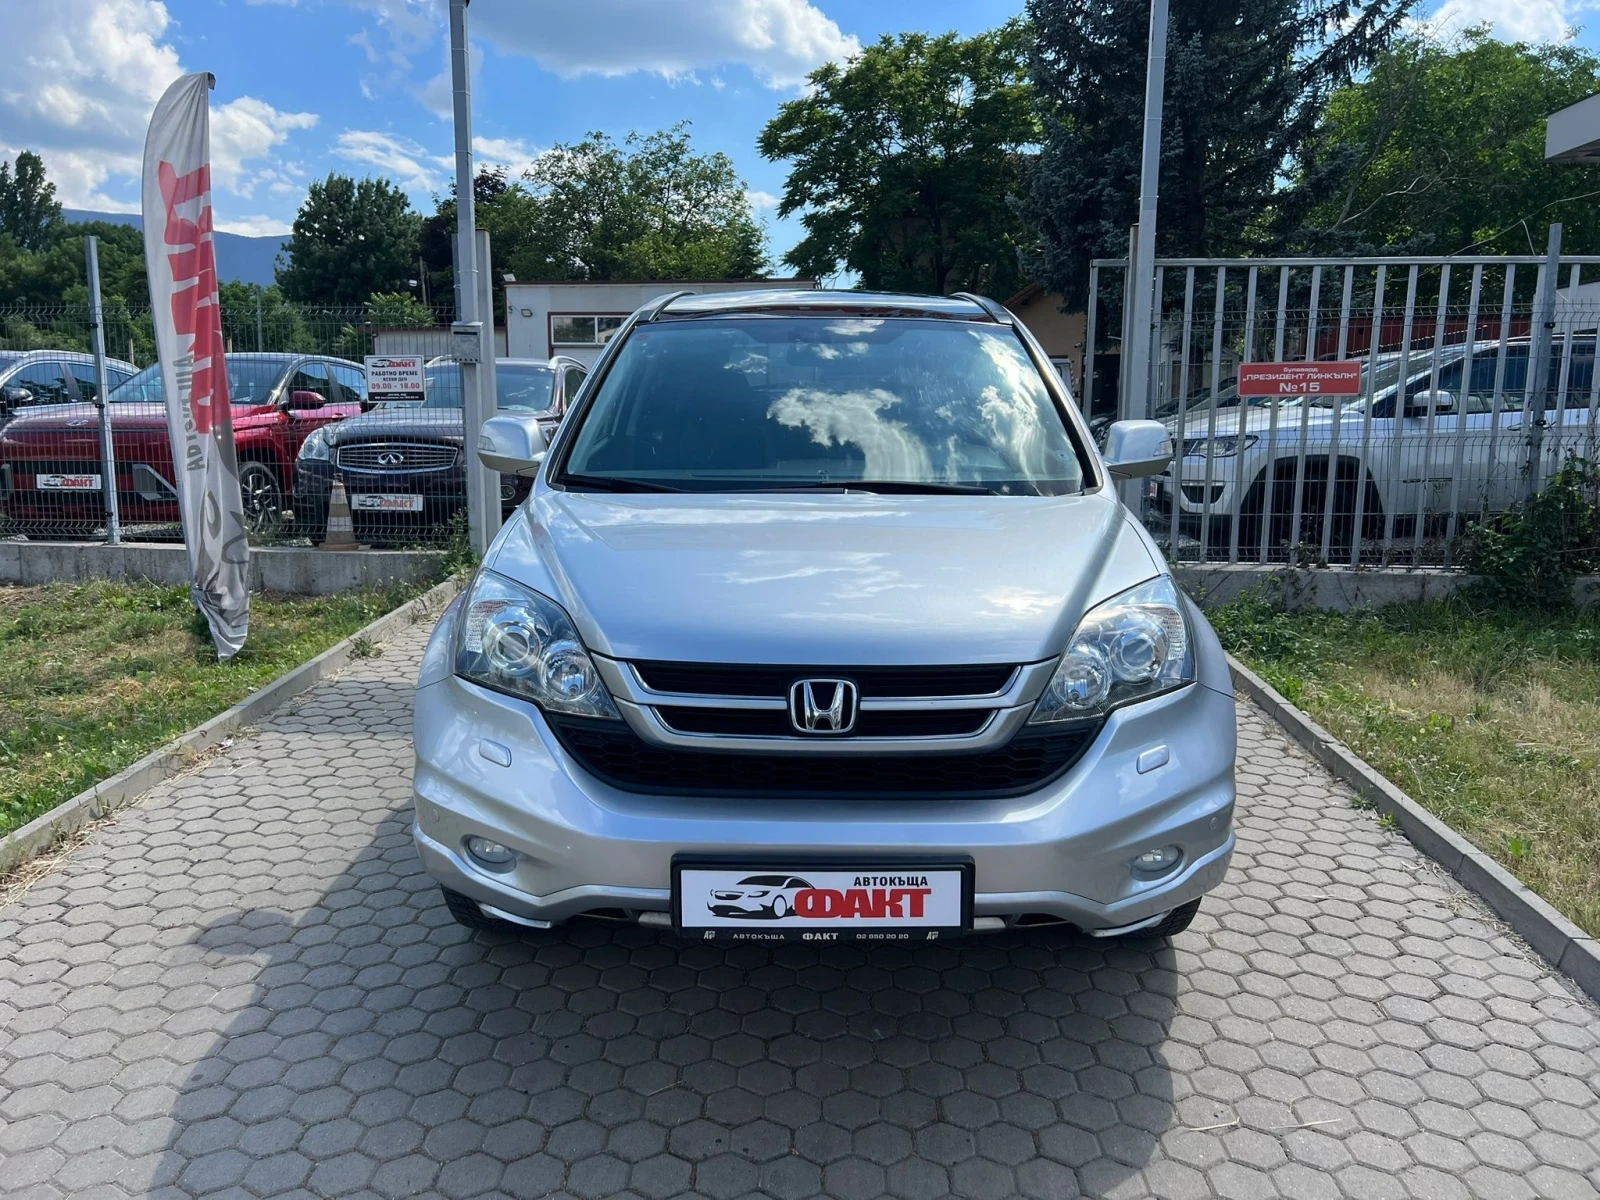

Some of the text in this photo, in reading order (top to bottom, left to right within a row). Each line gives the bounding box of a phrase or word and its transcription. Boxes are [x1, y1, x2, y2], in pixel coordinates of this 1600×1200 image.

[853, 876, 928, 888] АВТОКЪЩА
[794, 888, 932, 918] ФАКТ
[802, 932, 839, 941] ФАКТ
